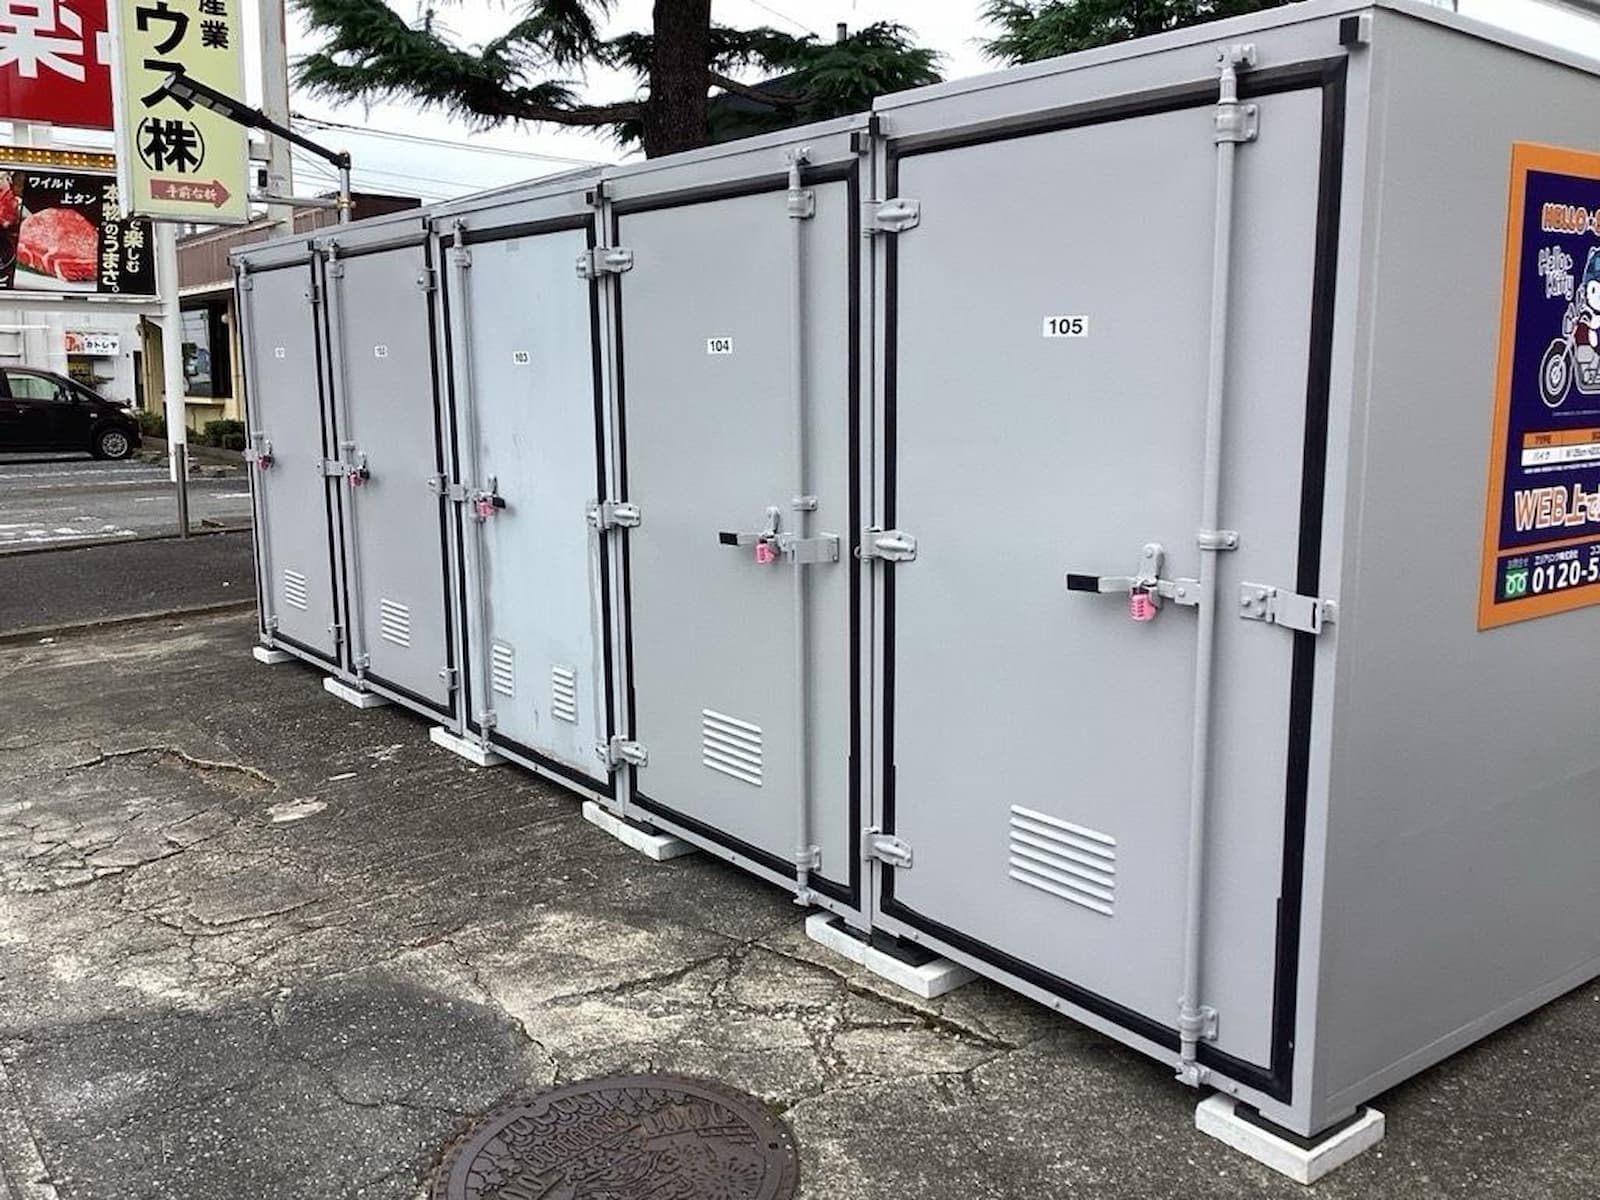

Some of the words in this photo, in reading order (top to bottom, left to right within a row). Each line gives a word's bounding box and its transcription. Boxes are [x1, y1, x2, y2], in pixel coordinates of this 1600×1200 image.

[28, 176, 76, 191] ワイルド
[60, 191, 97, 205] 上タン
[1049, 318, 1083, 335] 105
[709, 340, 730, 353] 104
